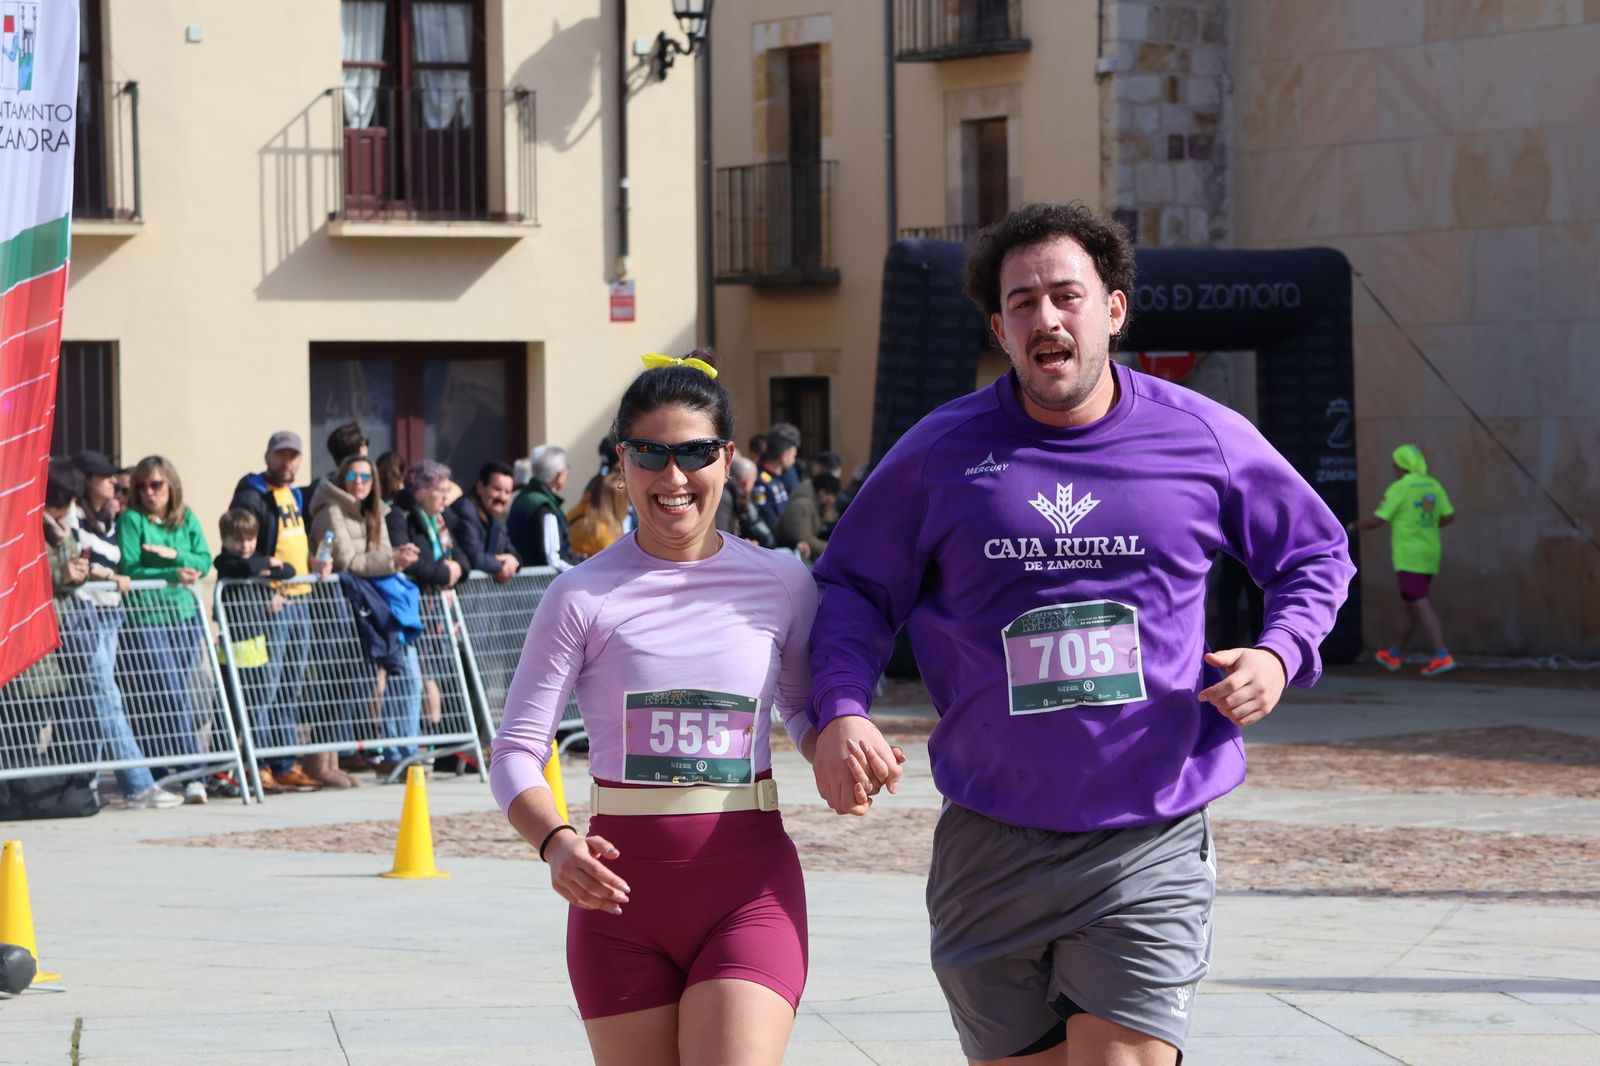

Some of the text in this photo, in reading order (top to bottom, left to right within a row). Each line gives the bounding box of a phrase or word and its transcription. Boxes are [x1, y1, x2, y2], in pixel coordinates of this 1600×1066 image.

[965, 463, 1009, 476] MERCURY
[984, 535, 1145, 560] CAJA RURAL
[1024, 559, 1103, 571] DE ZAMORA
[1029, 630, 1115, 679] 705
[649, 711, 731, 755] 555
